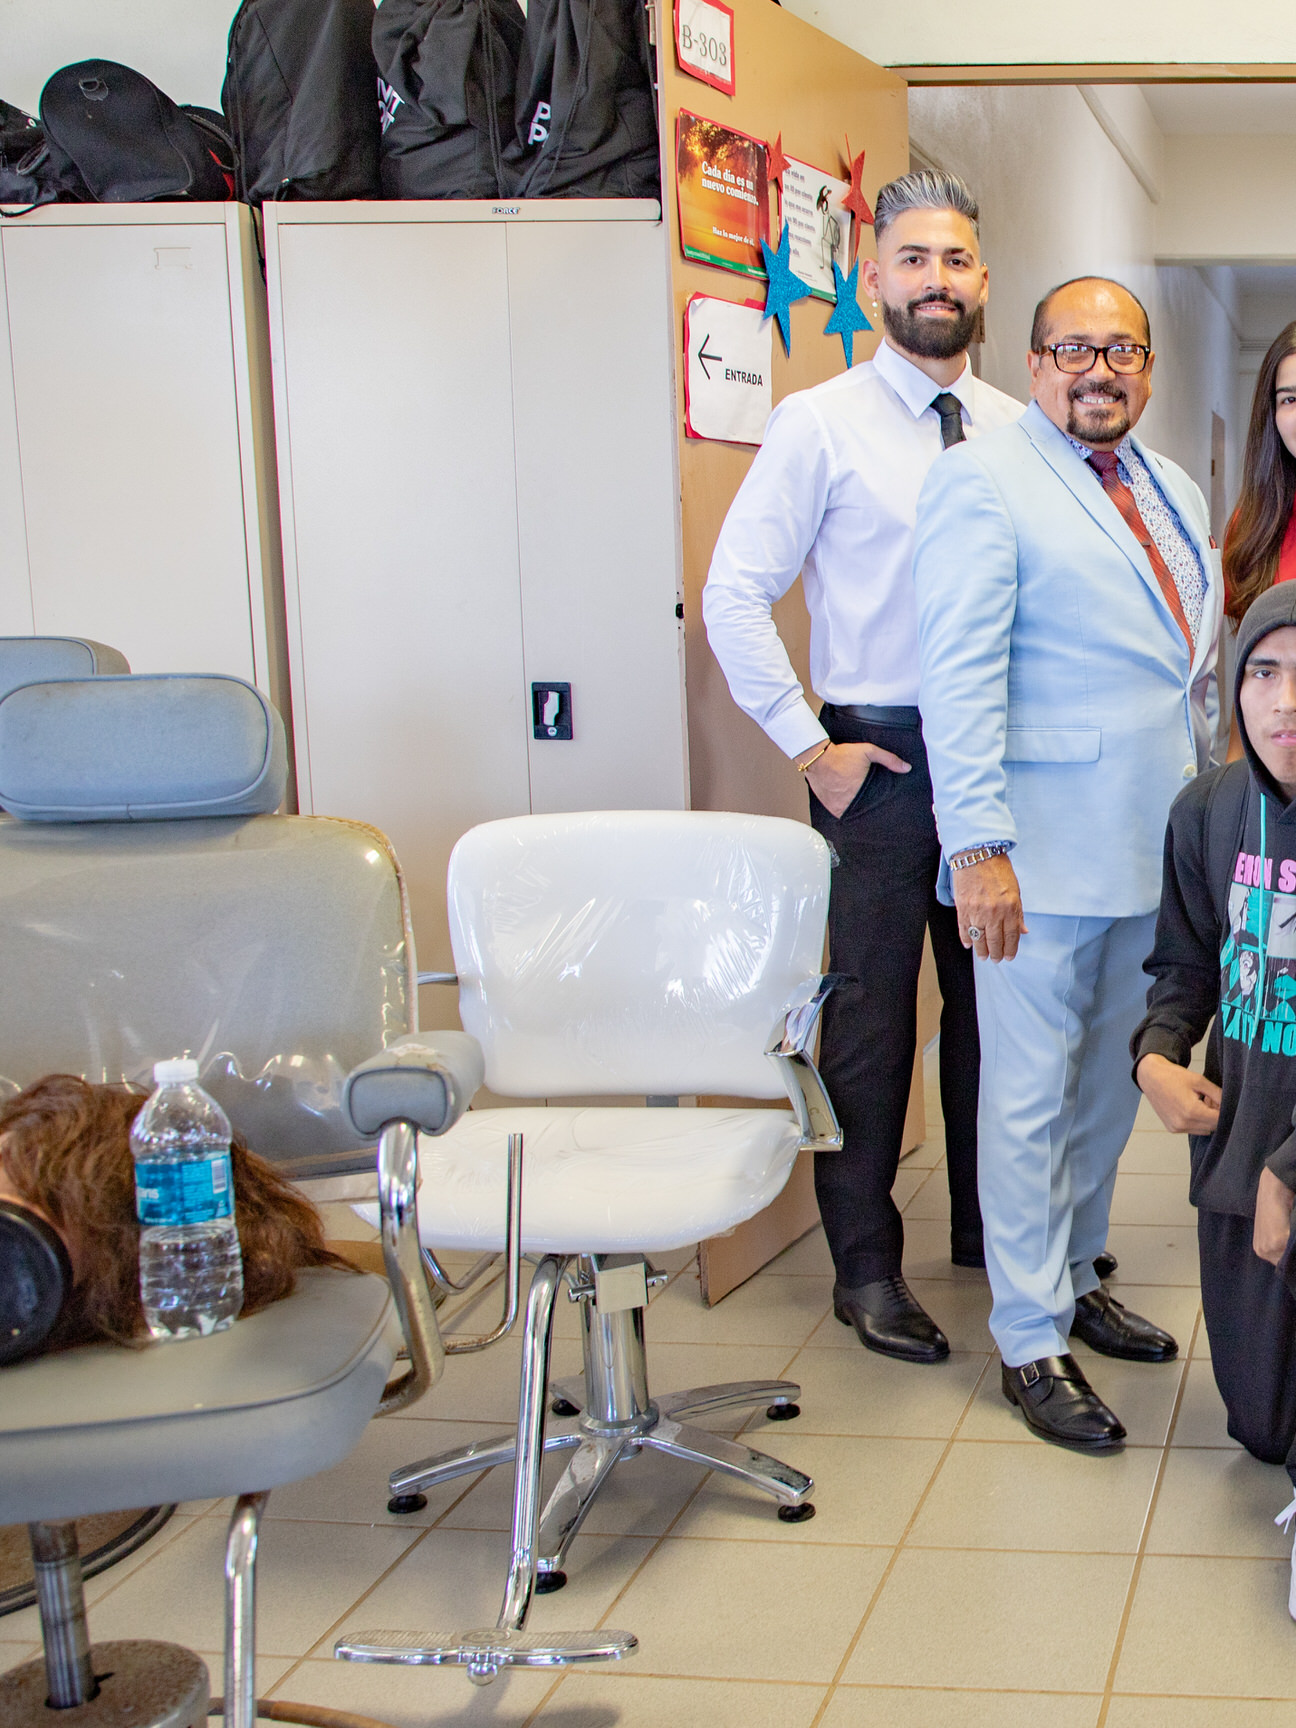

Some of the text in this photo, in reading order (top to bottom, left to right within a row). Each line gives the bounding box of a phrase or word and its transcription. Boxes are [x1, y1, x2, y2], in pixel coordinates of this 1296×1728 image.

[682, 24, 727, 66] B-303
[701, 177, 725, 194] nuevo
[702, 160, 722, 180] Cada
[736, 176, 746, 188] es
[725, 368, 763, 387] ENTRADA
[1233, 851, 1273, 891] EMON
